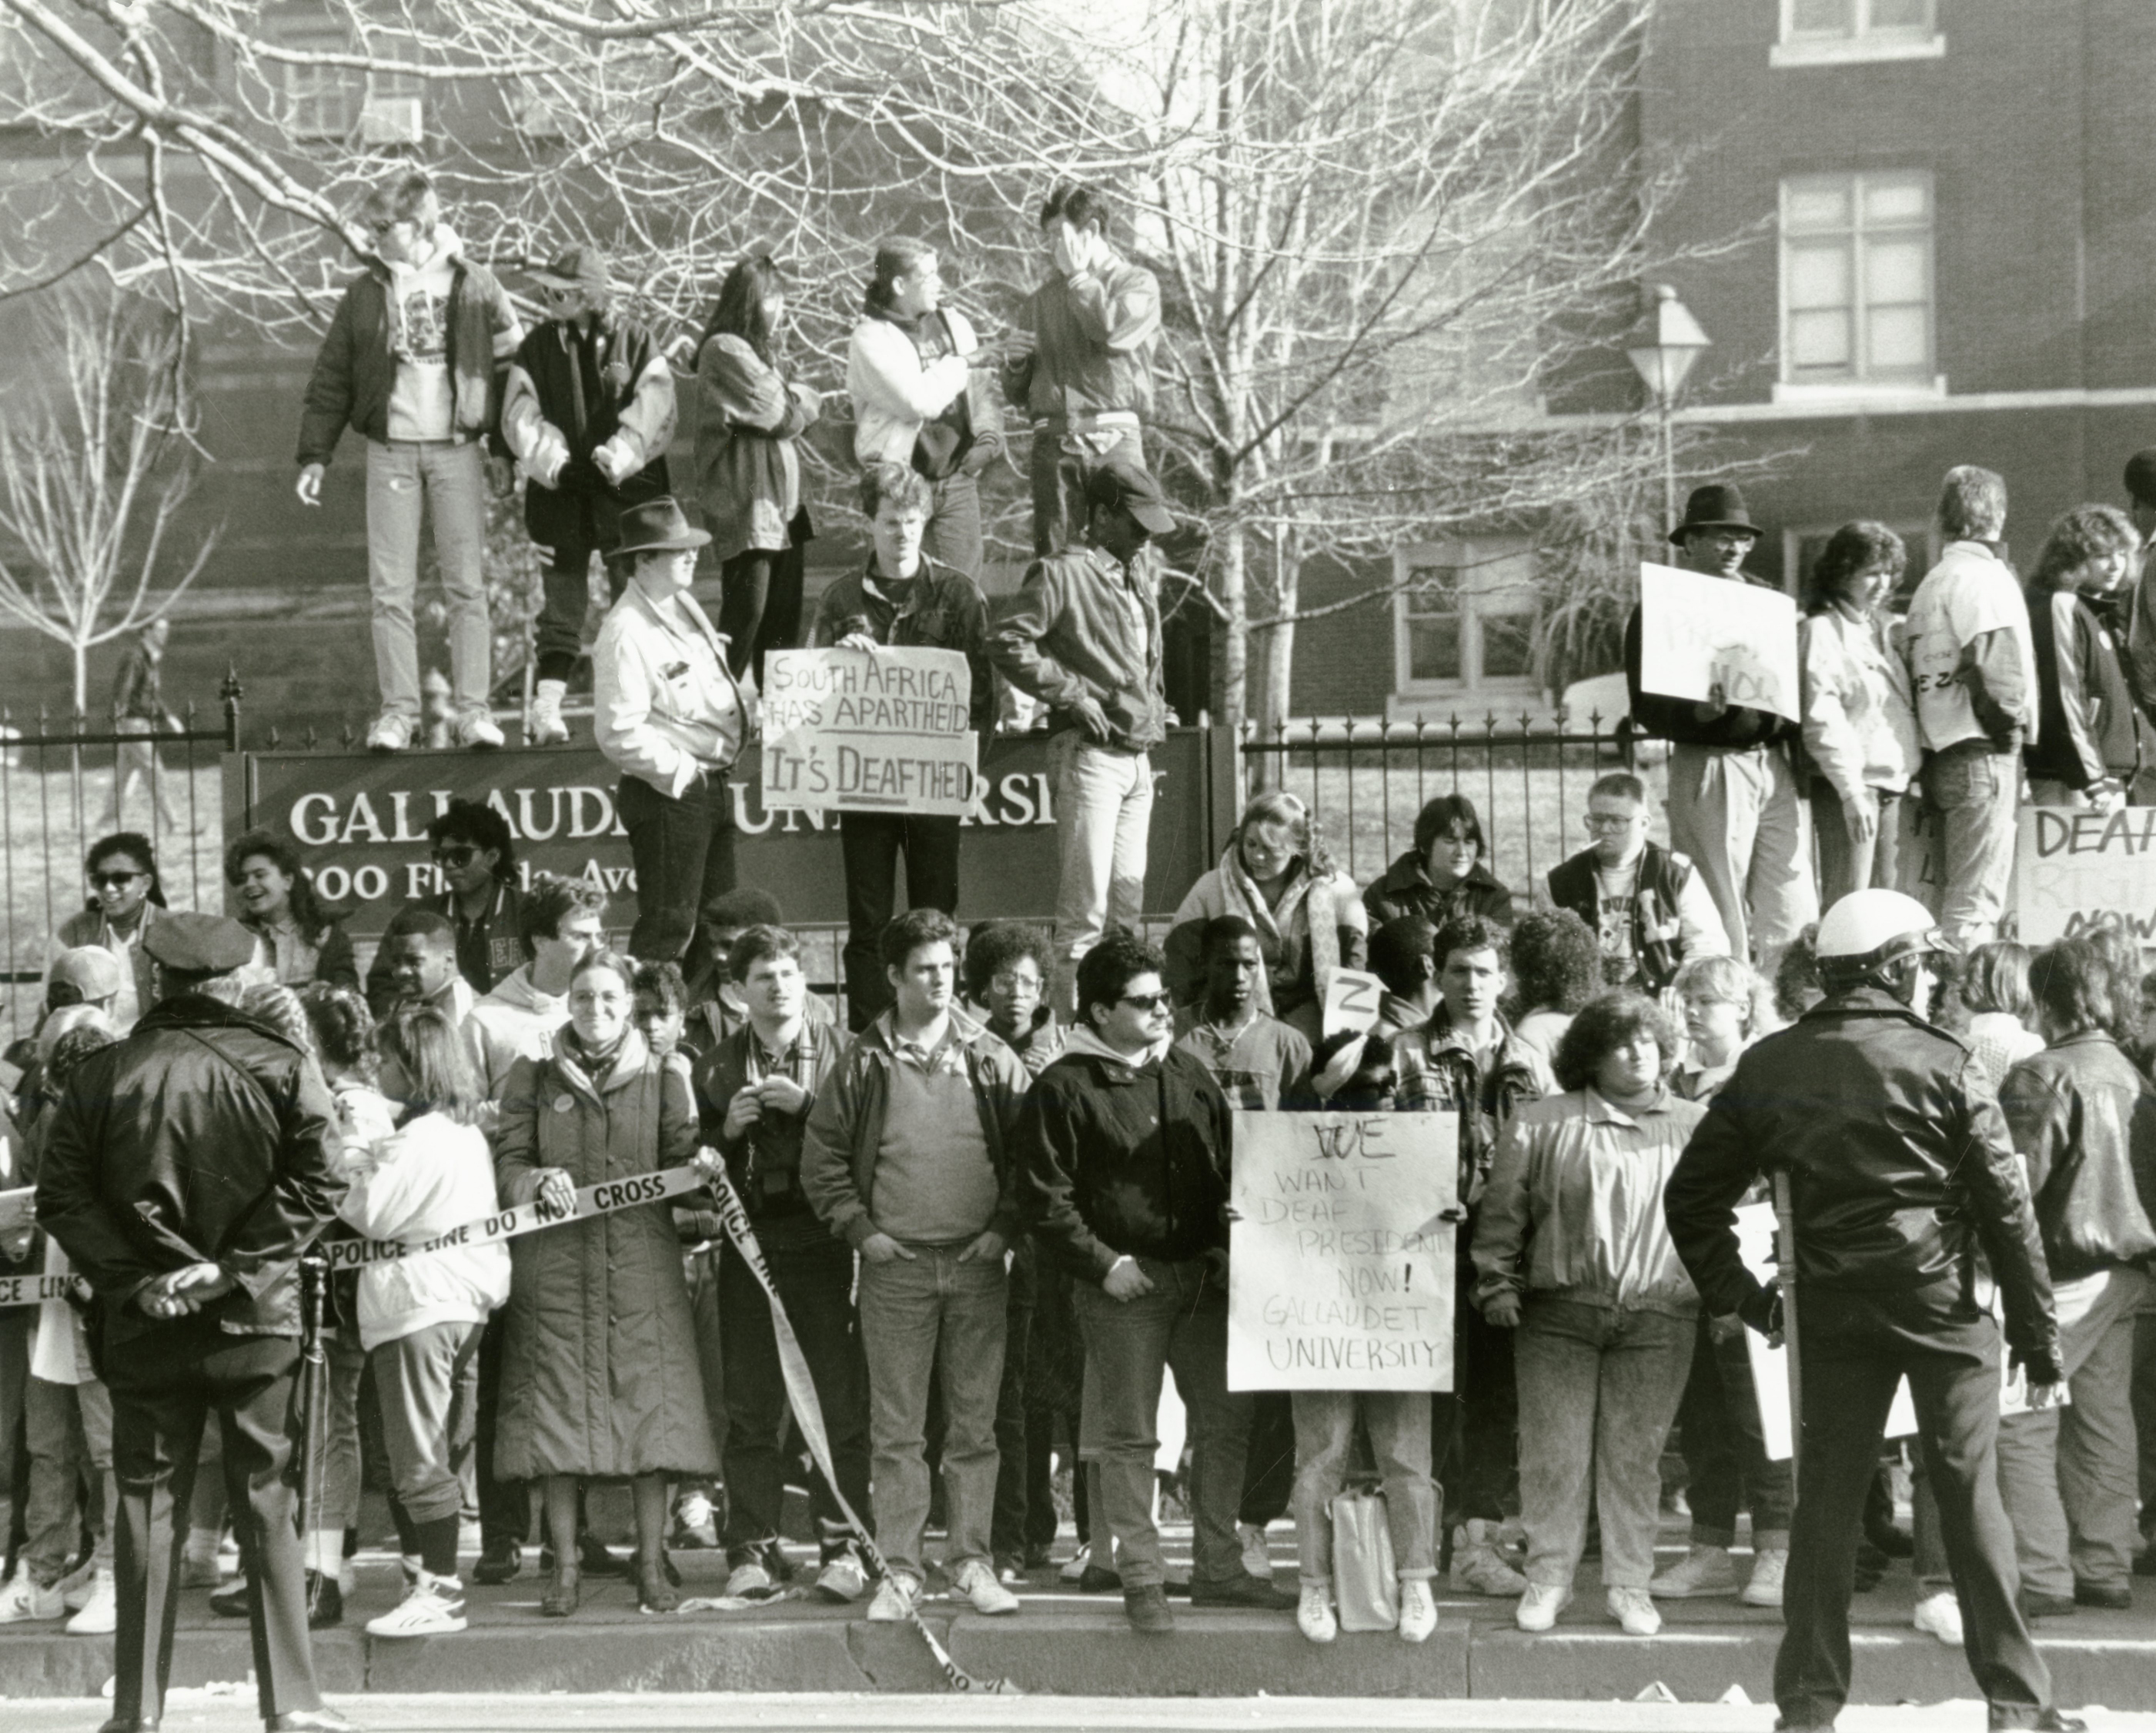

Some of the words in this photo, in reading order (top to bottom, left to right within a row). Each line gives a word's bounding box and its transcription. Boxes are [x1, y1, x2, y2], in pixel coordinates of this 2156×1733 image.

[774, 656, 857, 692] SOUTH
[864, 654, 958, 702] AFRICA
[770, 700, 823, 726] HAS
[834, 696, 968, 732] APARTHEID
[766, 746, 829, 793] IT'S
[301, 866, 388, 900] 00
[1273, 1165, 1380, 1194] WANT
[485, 1210, 517, 1237] DO
[593, 1174, 666, 1210] CROSS
[1259, 1197, 1352, 1225] DEAF
[1263, 1294, 1427, 1331] GALLAUDET
[1266, 1337, 1442, 1371] UNIVERSITY
